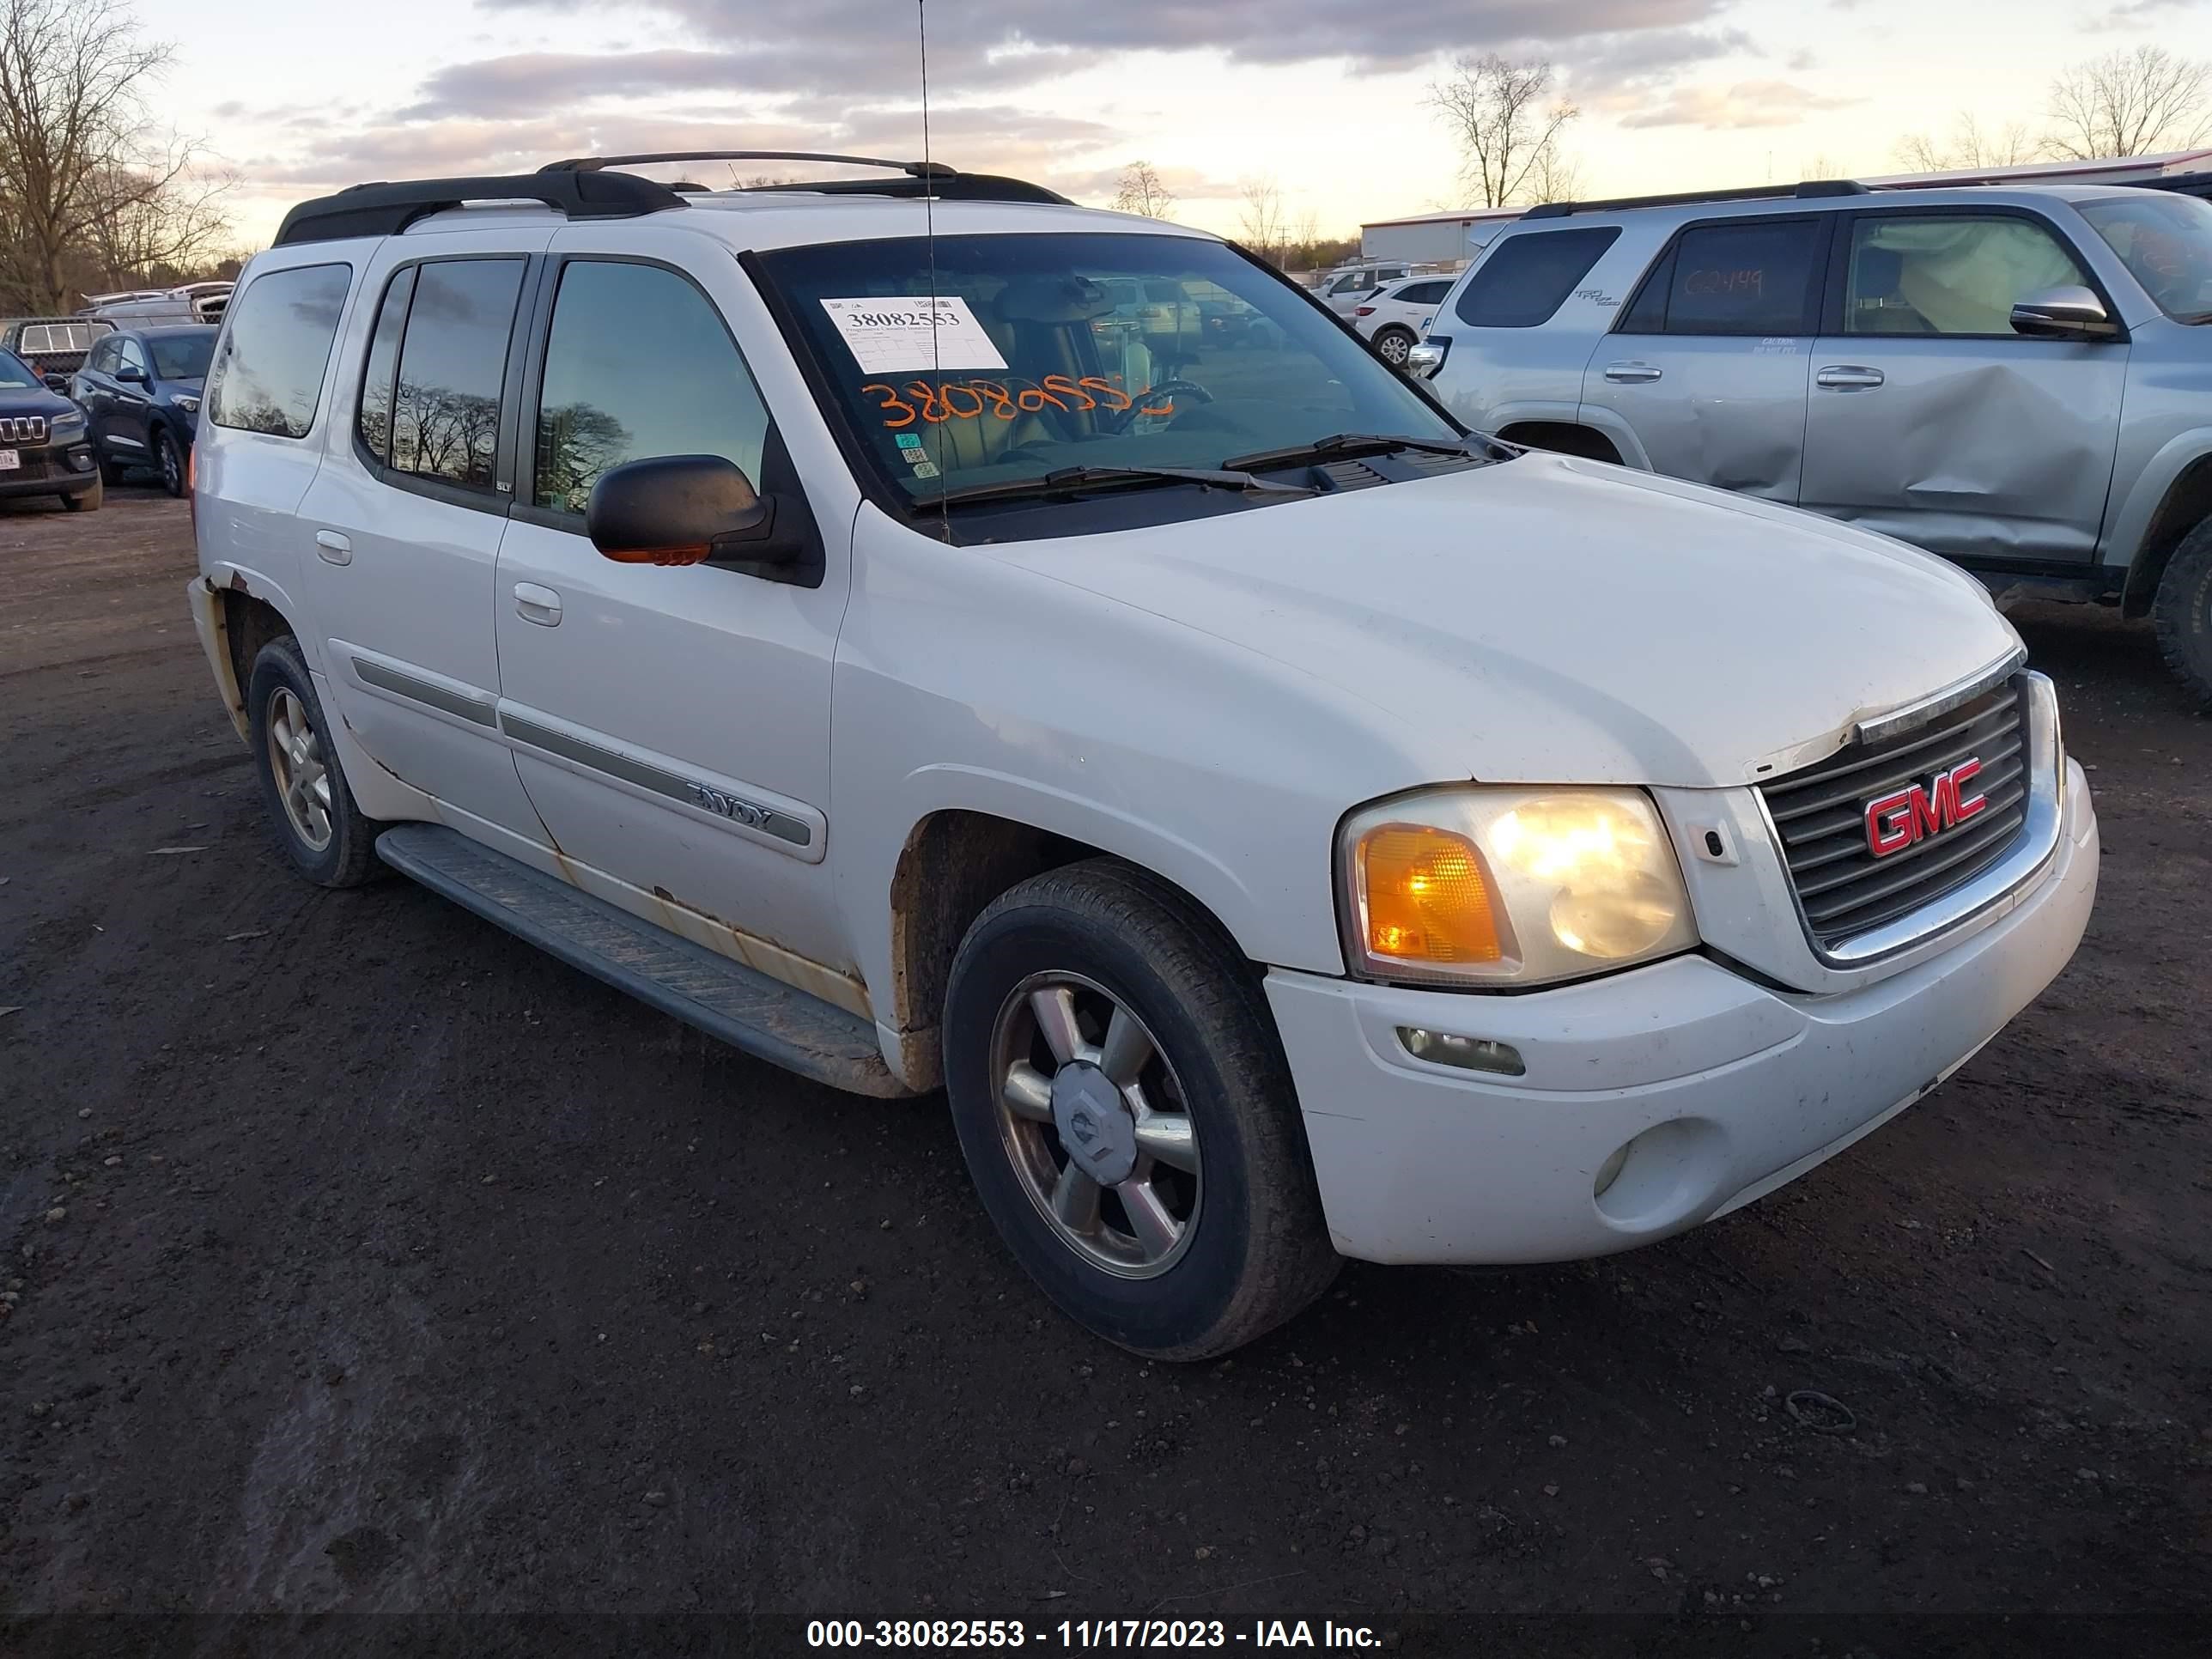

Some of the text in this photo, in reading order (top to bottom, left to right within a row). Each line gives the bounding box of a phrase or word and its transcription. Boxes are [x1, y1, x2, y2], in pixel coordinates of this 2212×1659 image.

[847, 313, 961, 327] 38082553
[687, 783, 773, 830] ENVOY
[1865, 757, 1990, 858] GMC
